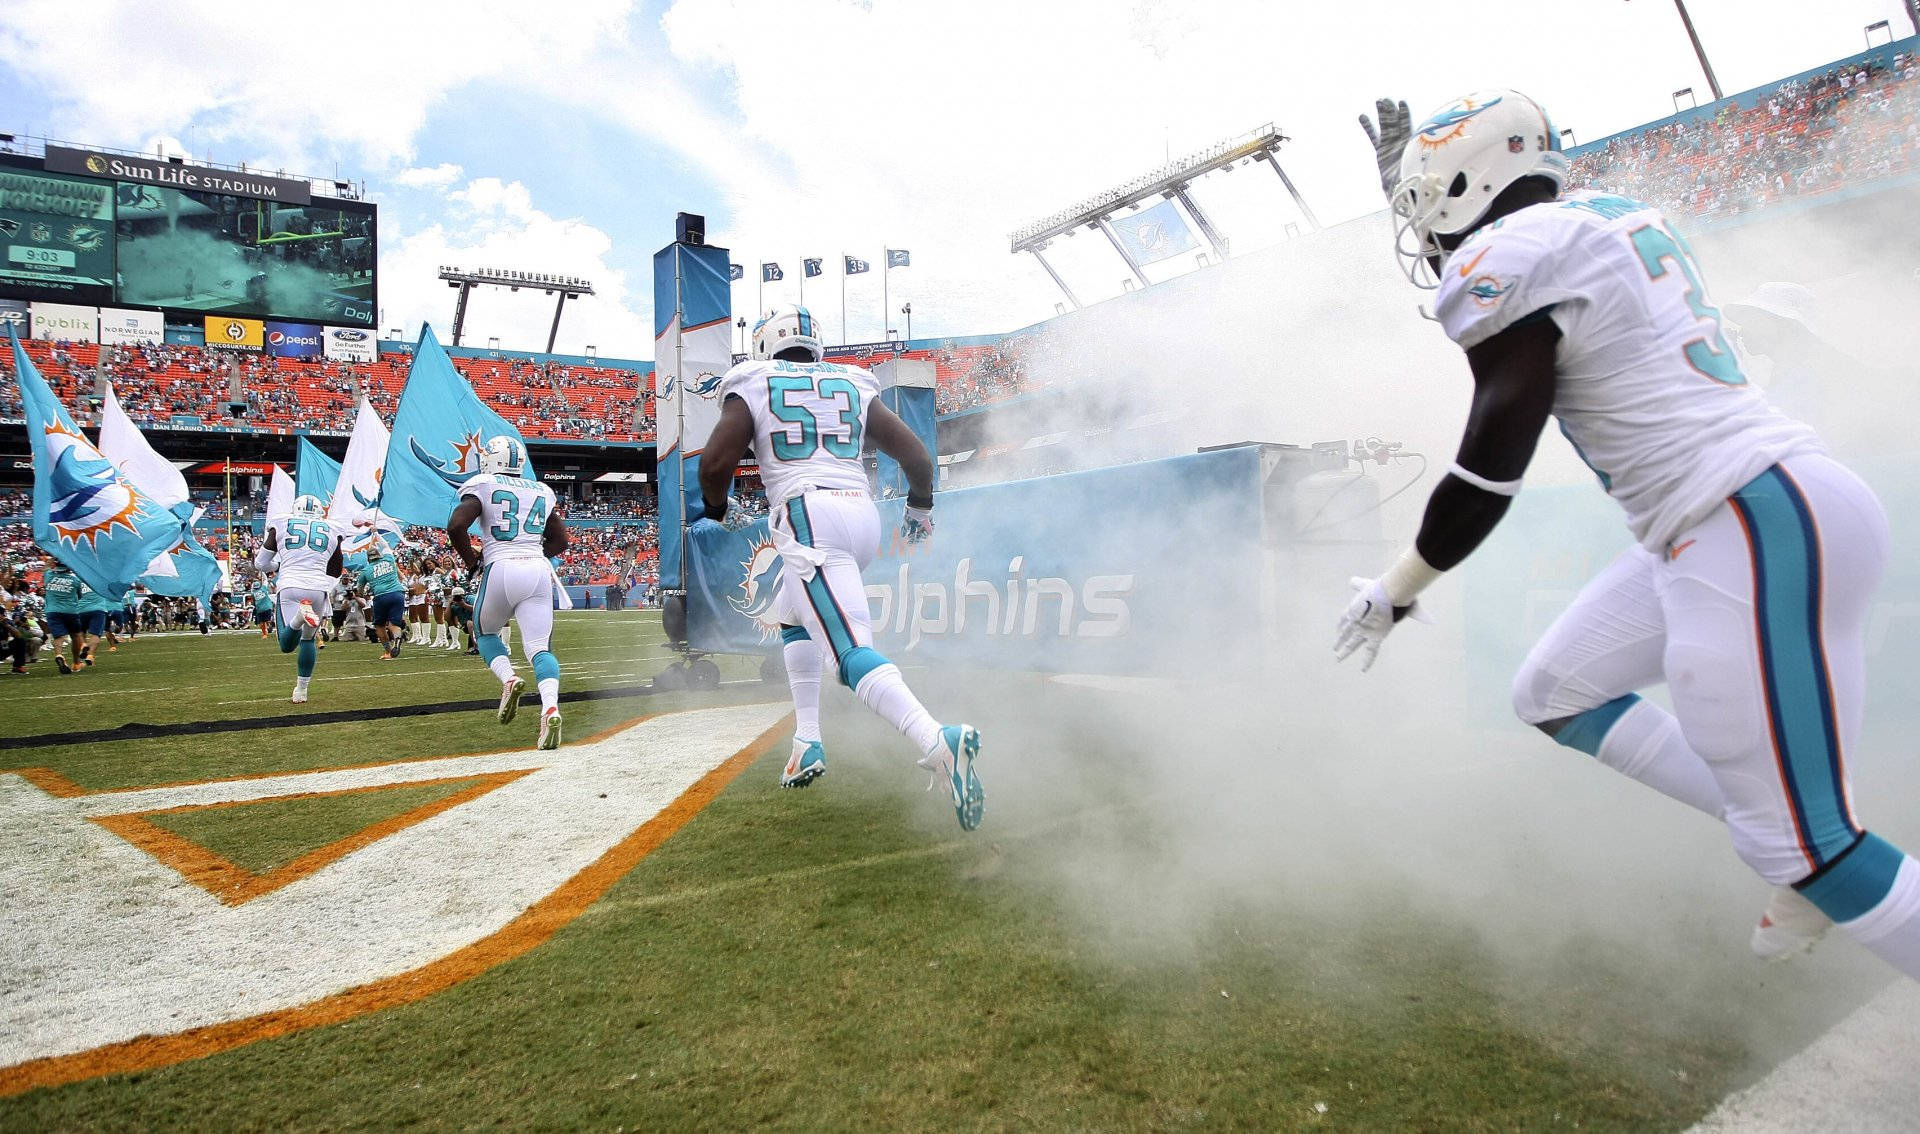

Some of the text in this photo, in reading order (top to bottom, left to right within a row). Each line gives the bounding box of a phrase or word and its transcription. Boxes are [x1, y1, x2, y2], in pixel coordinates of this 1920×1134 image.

[110, 160, 277, 197] Sun Life STADIUM
[26, 249, 59, 262] 9:03
[851, 260, 864, 272] 39
[104, 327, 160, 336] NORWEGIAN
[340, 331, 362, 341] Ford
[287, 337, 318, 346] pepsi
[768, 375, 863, 461] 53
[153, 423, 170, 431] DAN
[172, 424, 202, 433] MARINO
[205, 425, 213, 433] 13
[222, 466, 264, 474] Dolphins
[491, 489, 547, 541] 34
[285, 518, 330, 554] 56
[864, 556, 1136, 650] olphins
